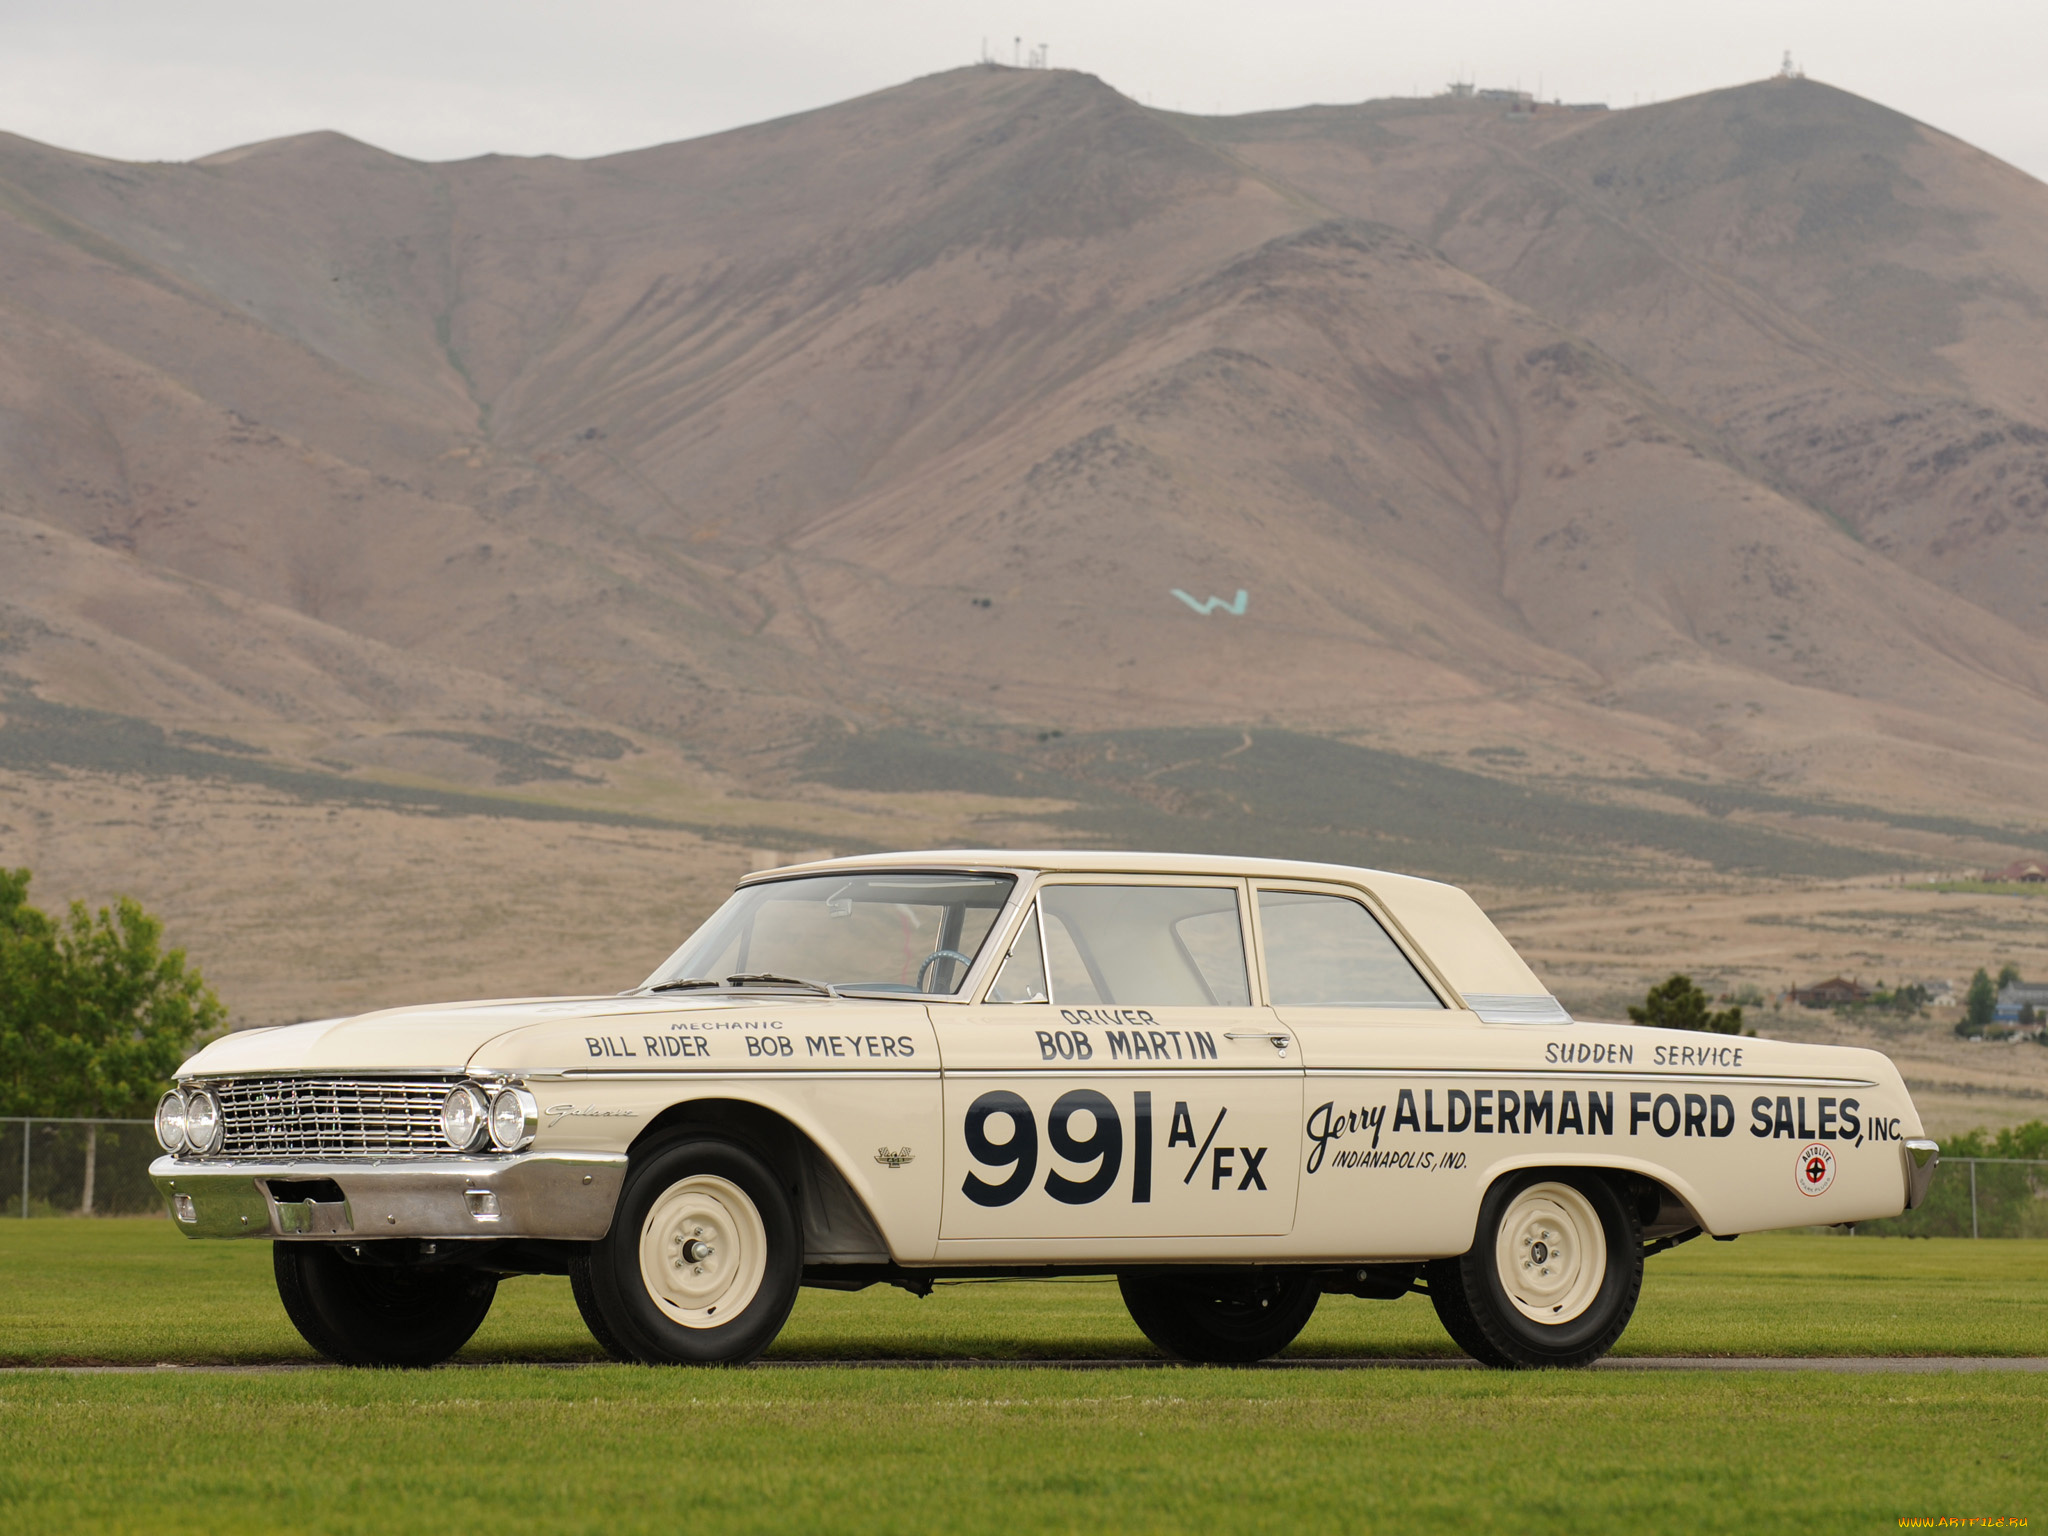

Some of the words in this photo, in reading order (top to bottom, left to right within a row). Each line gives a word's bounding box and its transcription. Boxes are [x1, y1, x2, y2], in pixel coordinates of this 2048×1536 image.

[1168, 588, 1248, 616] W
[671, 1021, 783, 1031] MECHANIC
[1060, 1009, 1160, 1025] DRIVER
[585, 1036, 636, 1057] BILL
[643, 1036, 710, 1057] RIDER
[745, 1036, 794, 1057] BOB
[805, 1036, 915, 1057] MEYERS
[1035, 1031, 1093, 1060] BOB
[1105, 1031, 1218, 1060] MARTIN
[1545, 1042, 1634, 1064] SUDDEN
[1653, 1045, 1743, 1067] SERVICE
[1306, 1101, 1386, 1174] Jerry
[1392, 1089, 1613, 1135] ALDERMAN
[1629, 1092, 1735, 1138] FORD
[1750, 1096, 1864, 1148] SALES,
[1869, 1117, 1904, 1141] INC.
[961, 1088, 1152, 1208] 991
[1802, 1146, 1832, 1163] AUTOLITE
